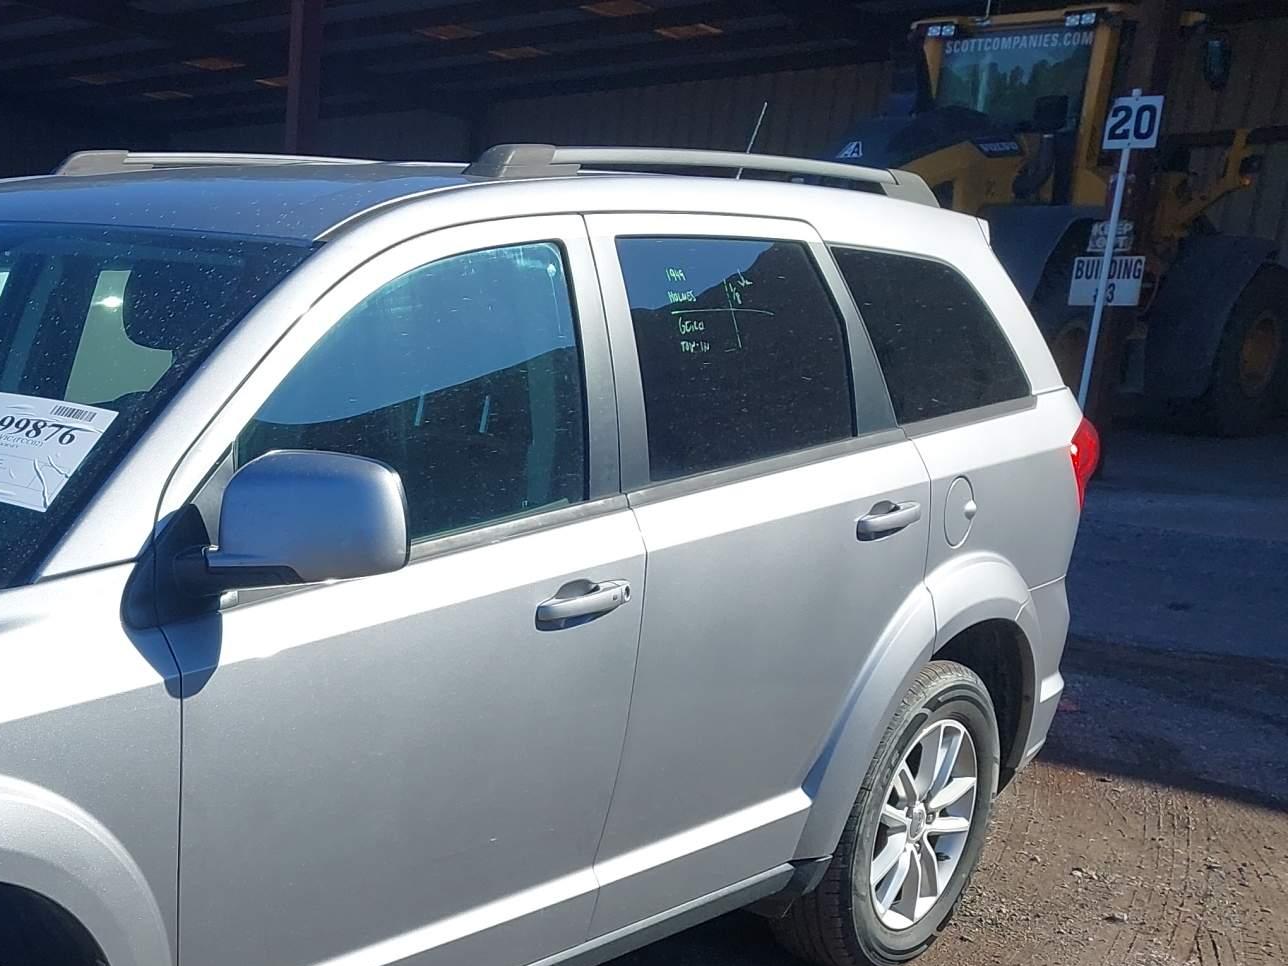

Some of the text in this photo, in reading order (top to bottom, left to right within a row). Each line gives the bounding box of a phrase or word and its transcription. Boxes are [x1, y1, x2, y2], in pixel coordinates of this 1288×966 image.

[945, 31, 1094, 54] SCOTTCOMPANIES.COM
[1107, 104, 1157, 140] 20
[1075, 259, 1143, 280] BUIDING
